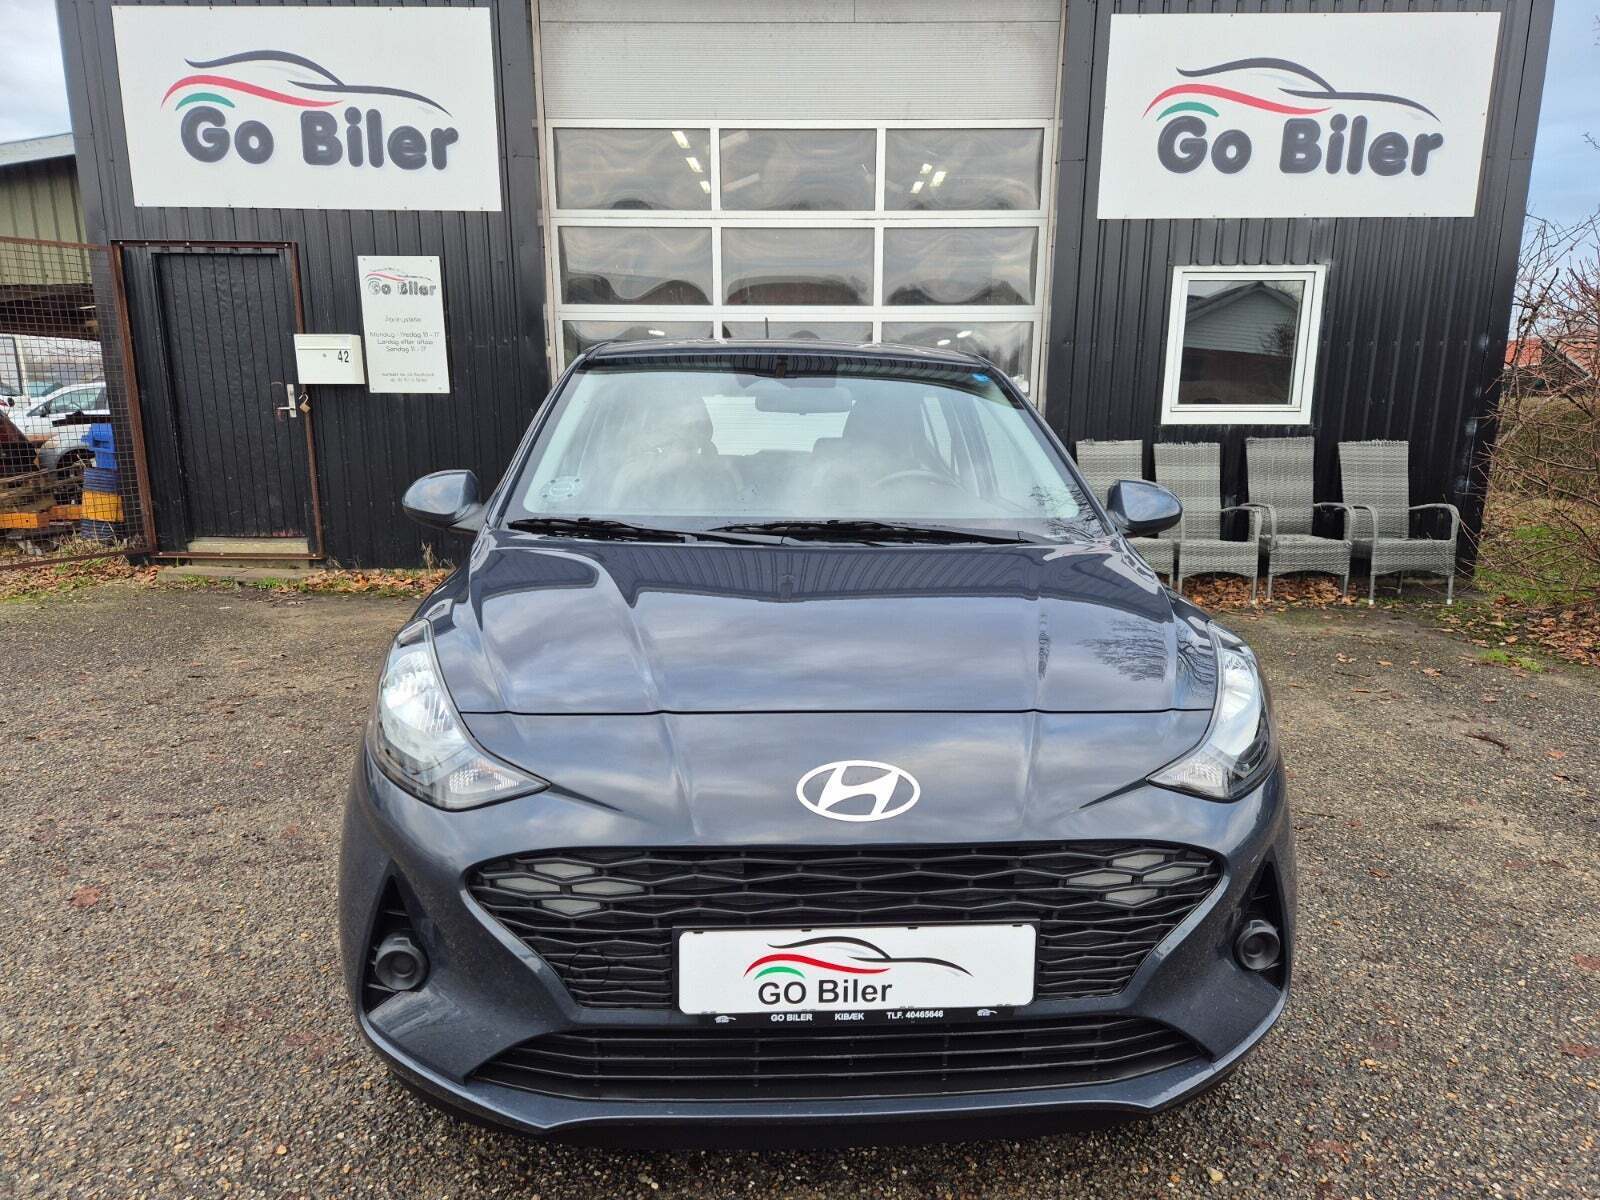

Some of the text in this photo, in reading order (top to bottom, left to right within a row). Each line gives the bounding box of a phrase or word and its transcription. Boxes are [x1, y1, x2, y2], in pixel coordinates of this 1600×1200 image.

[180, 106, 459, 171] Go Biler
[1157, 113, 1443, 177] Go Biler
[338, 350, 350, 363] 42
[757, 978, 893, 1005] GO Biler
[771, 1013, 785, 1021] GO
[786, 1013, 813, 1021] BILER
[834, 1012, 865, 1021] KIBÆK
[886, 1011, 904, 1020] TLF.
